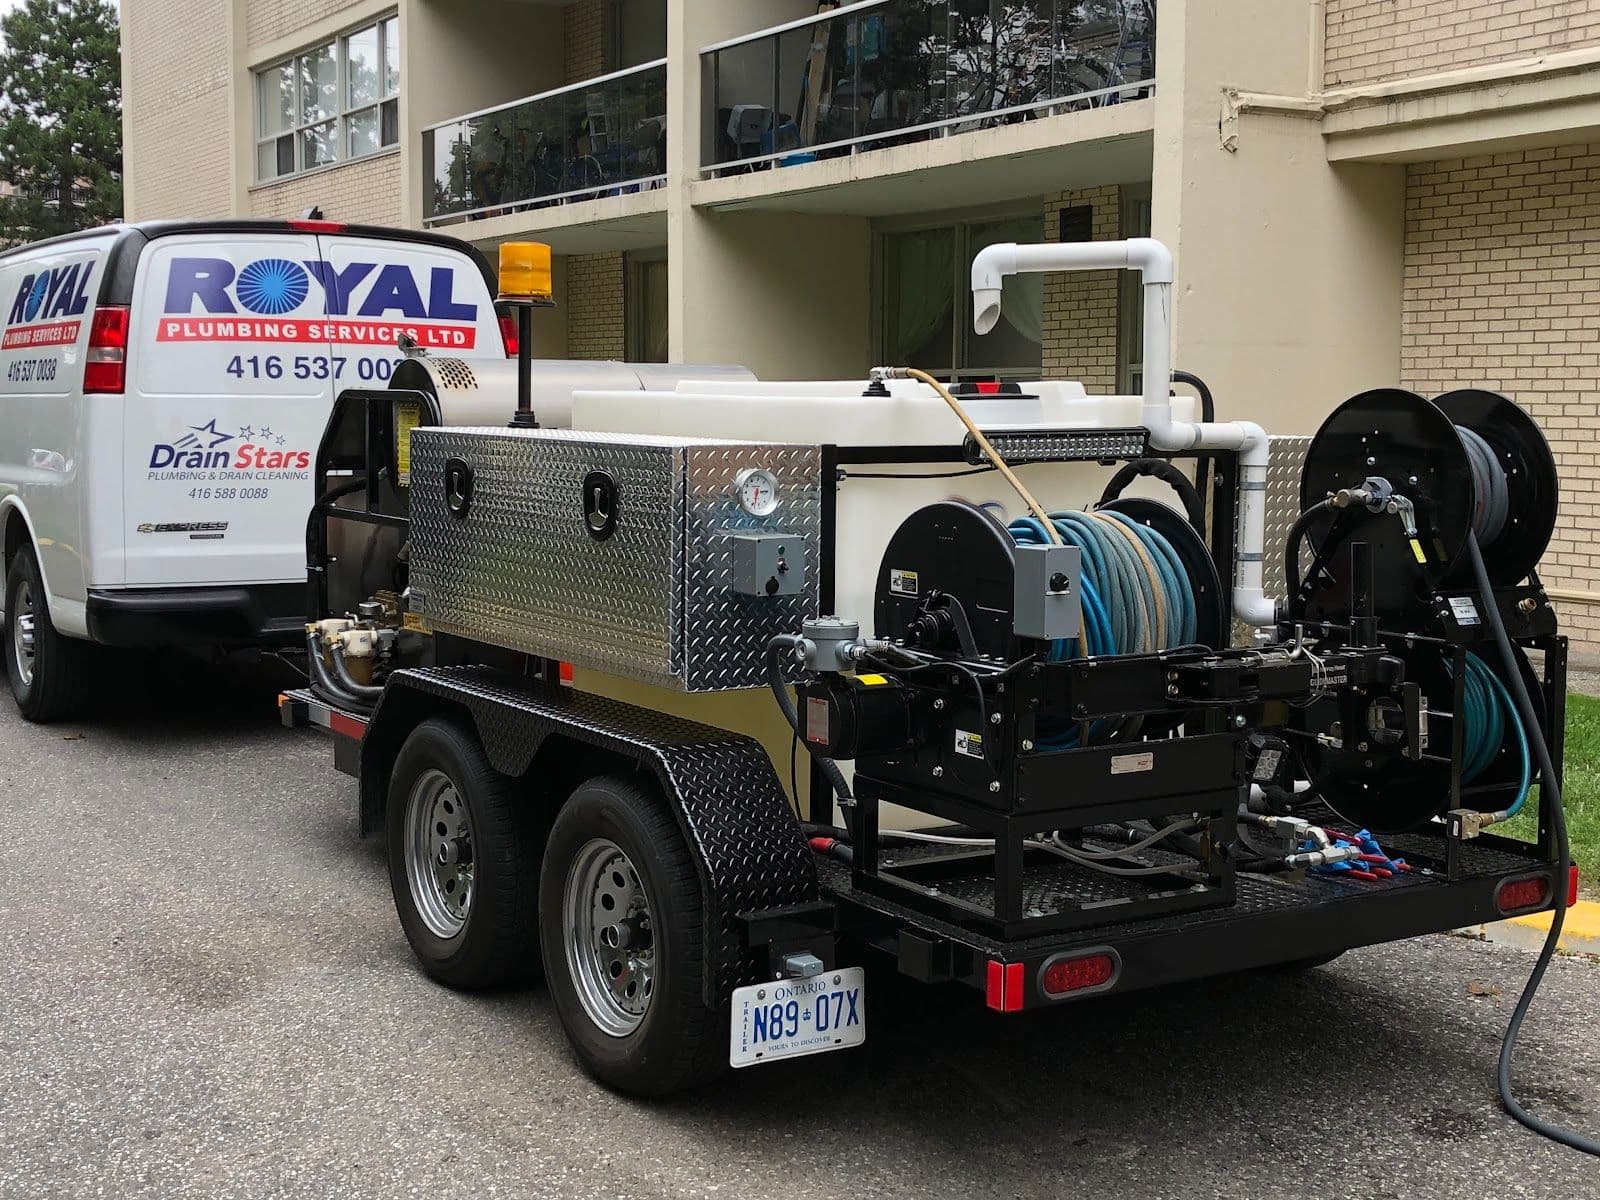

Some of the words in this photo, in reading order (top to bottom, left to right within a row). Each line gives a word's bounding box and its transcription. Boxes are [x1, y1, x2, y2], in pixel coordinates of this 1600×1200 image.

[8, 260, 96, 325] ROYAL
[163, 257, 477, 321] ROYAL
[4, 331, 32, 346] PLUMBING
[31, 327, 63, 342] SERVICES
[63, 325, 77, 340] LTD
[166, 322, 298, 338] PLUMBING
[427, 328, 466, 345] LTD
[8, 361, 21, 381] 416
[21, 360, 37, 381] 537
[36, 358, 57, 381] 0038
[226, 355, 283, 380] 416
[293, 356, 347, 380] 537
[358, 357, 403, 381] 00
[149, 444, 230, 469] Drain
[234, 443, 311, 469] Stars
[147, 471, 206, 481] PLUMBING
[208, 471, 217, 481] &
[218, 471, 253, 481] DRAIN
[255, 471, 309, 481] CLEANING
[188, 487, 211, 499] 416
[214, 487, 237, 499] 588
[239, 487, 269, 499] 0088
[775, 981, 826, 1001] ONTARIO
[742, 1001, 750, 1053] TRAILER
[753, 1000, 799, 1044] N89
[768, 1043, 789, 1052] YOURS
[800, 1036, 831, 1046] DISCOVER
